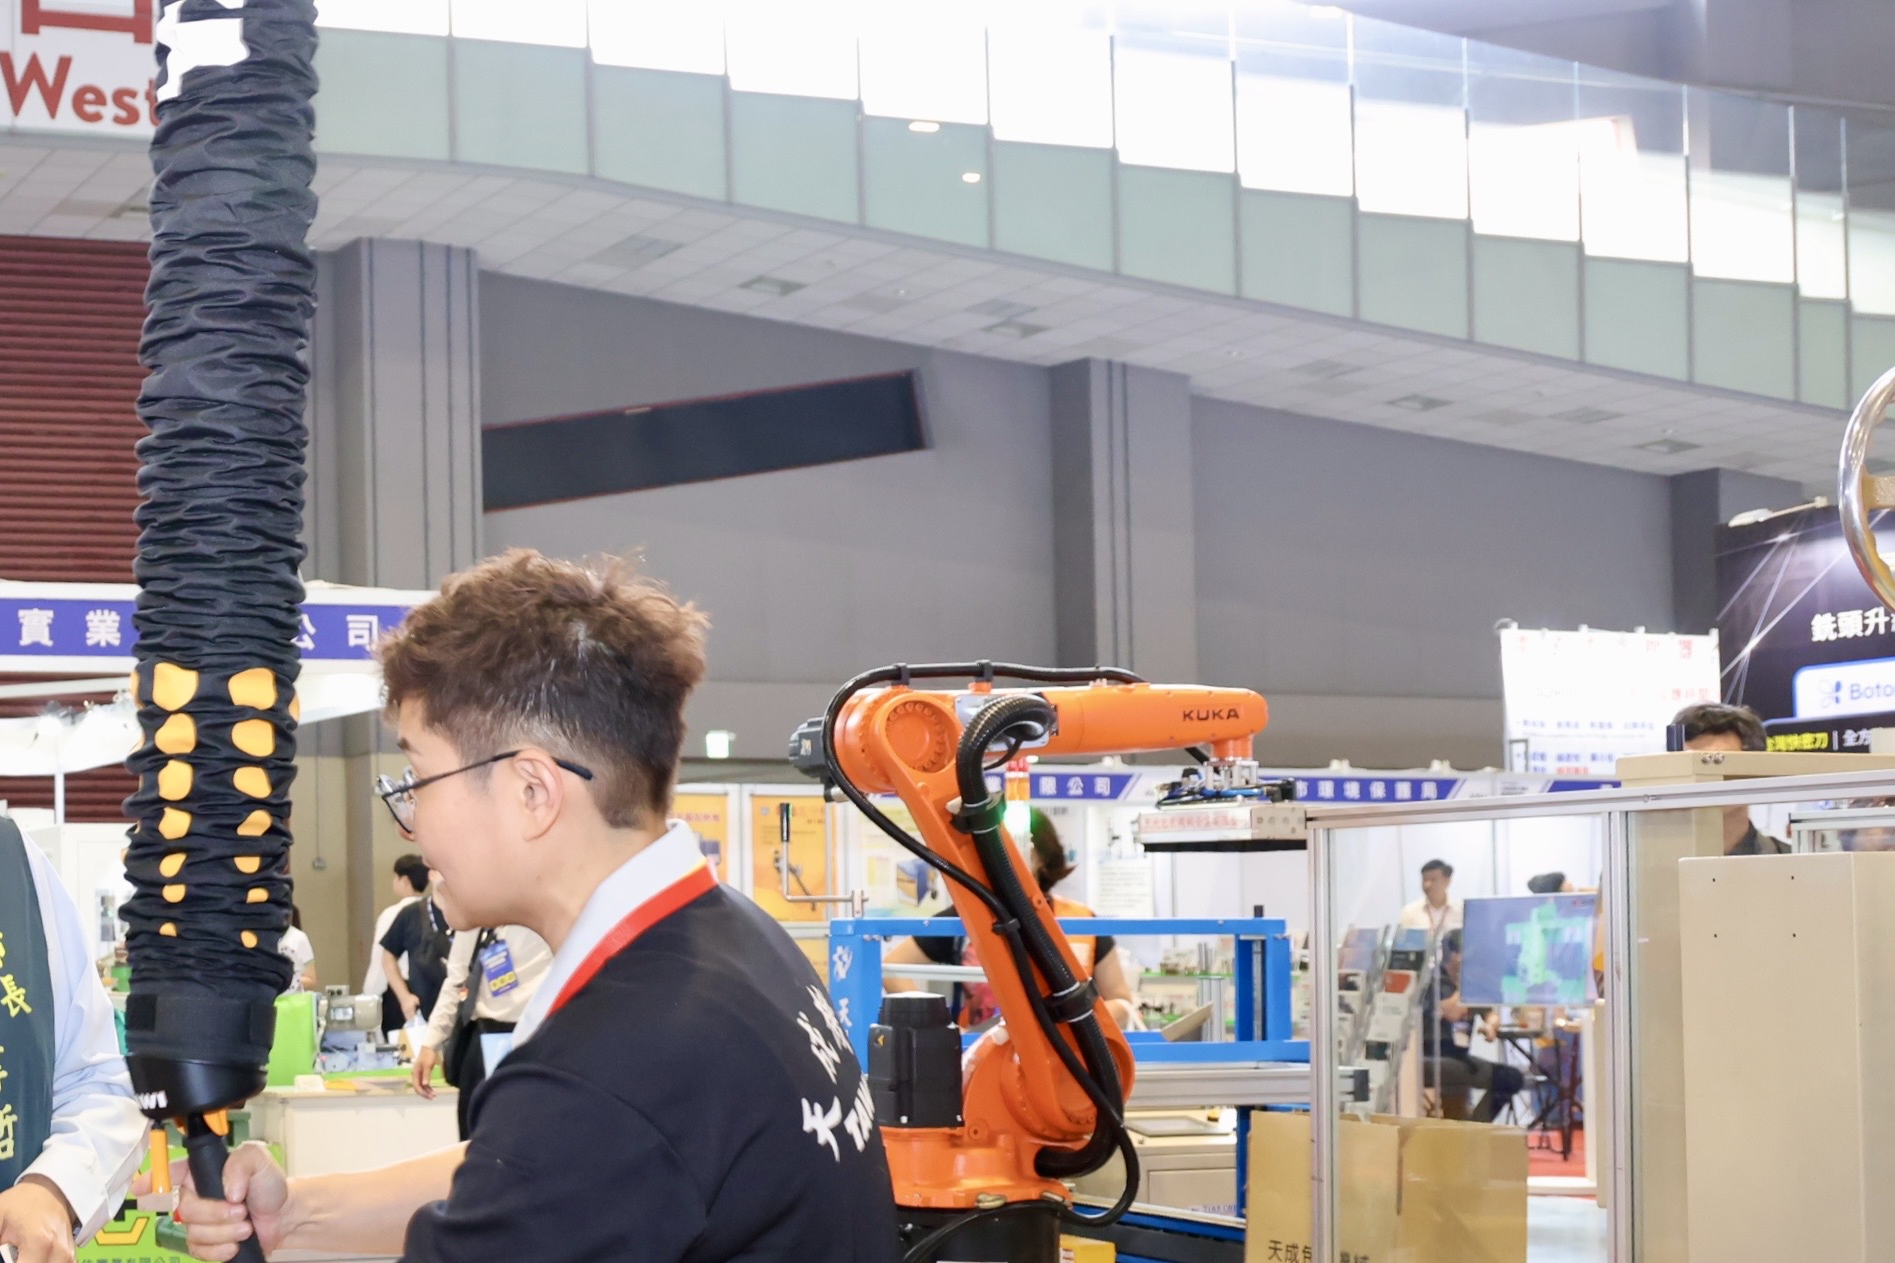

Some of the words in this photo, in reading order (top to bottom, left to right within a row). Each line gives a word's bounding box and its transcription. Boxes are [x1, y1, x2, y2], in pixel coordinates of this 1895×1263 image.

[1811, 606, 1895, 642] 銑頭升
[1182, 708, 1240, 722] KUKA
